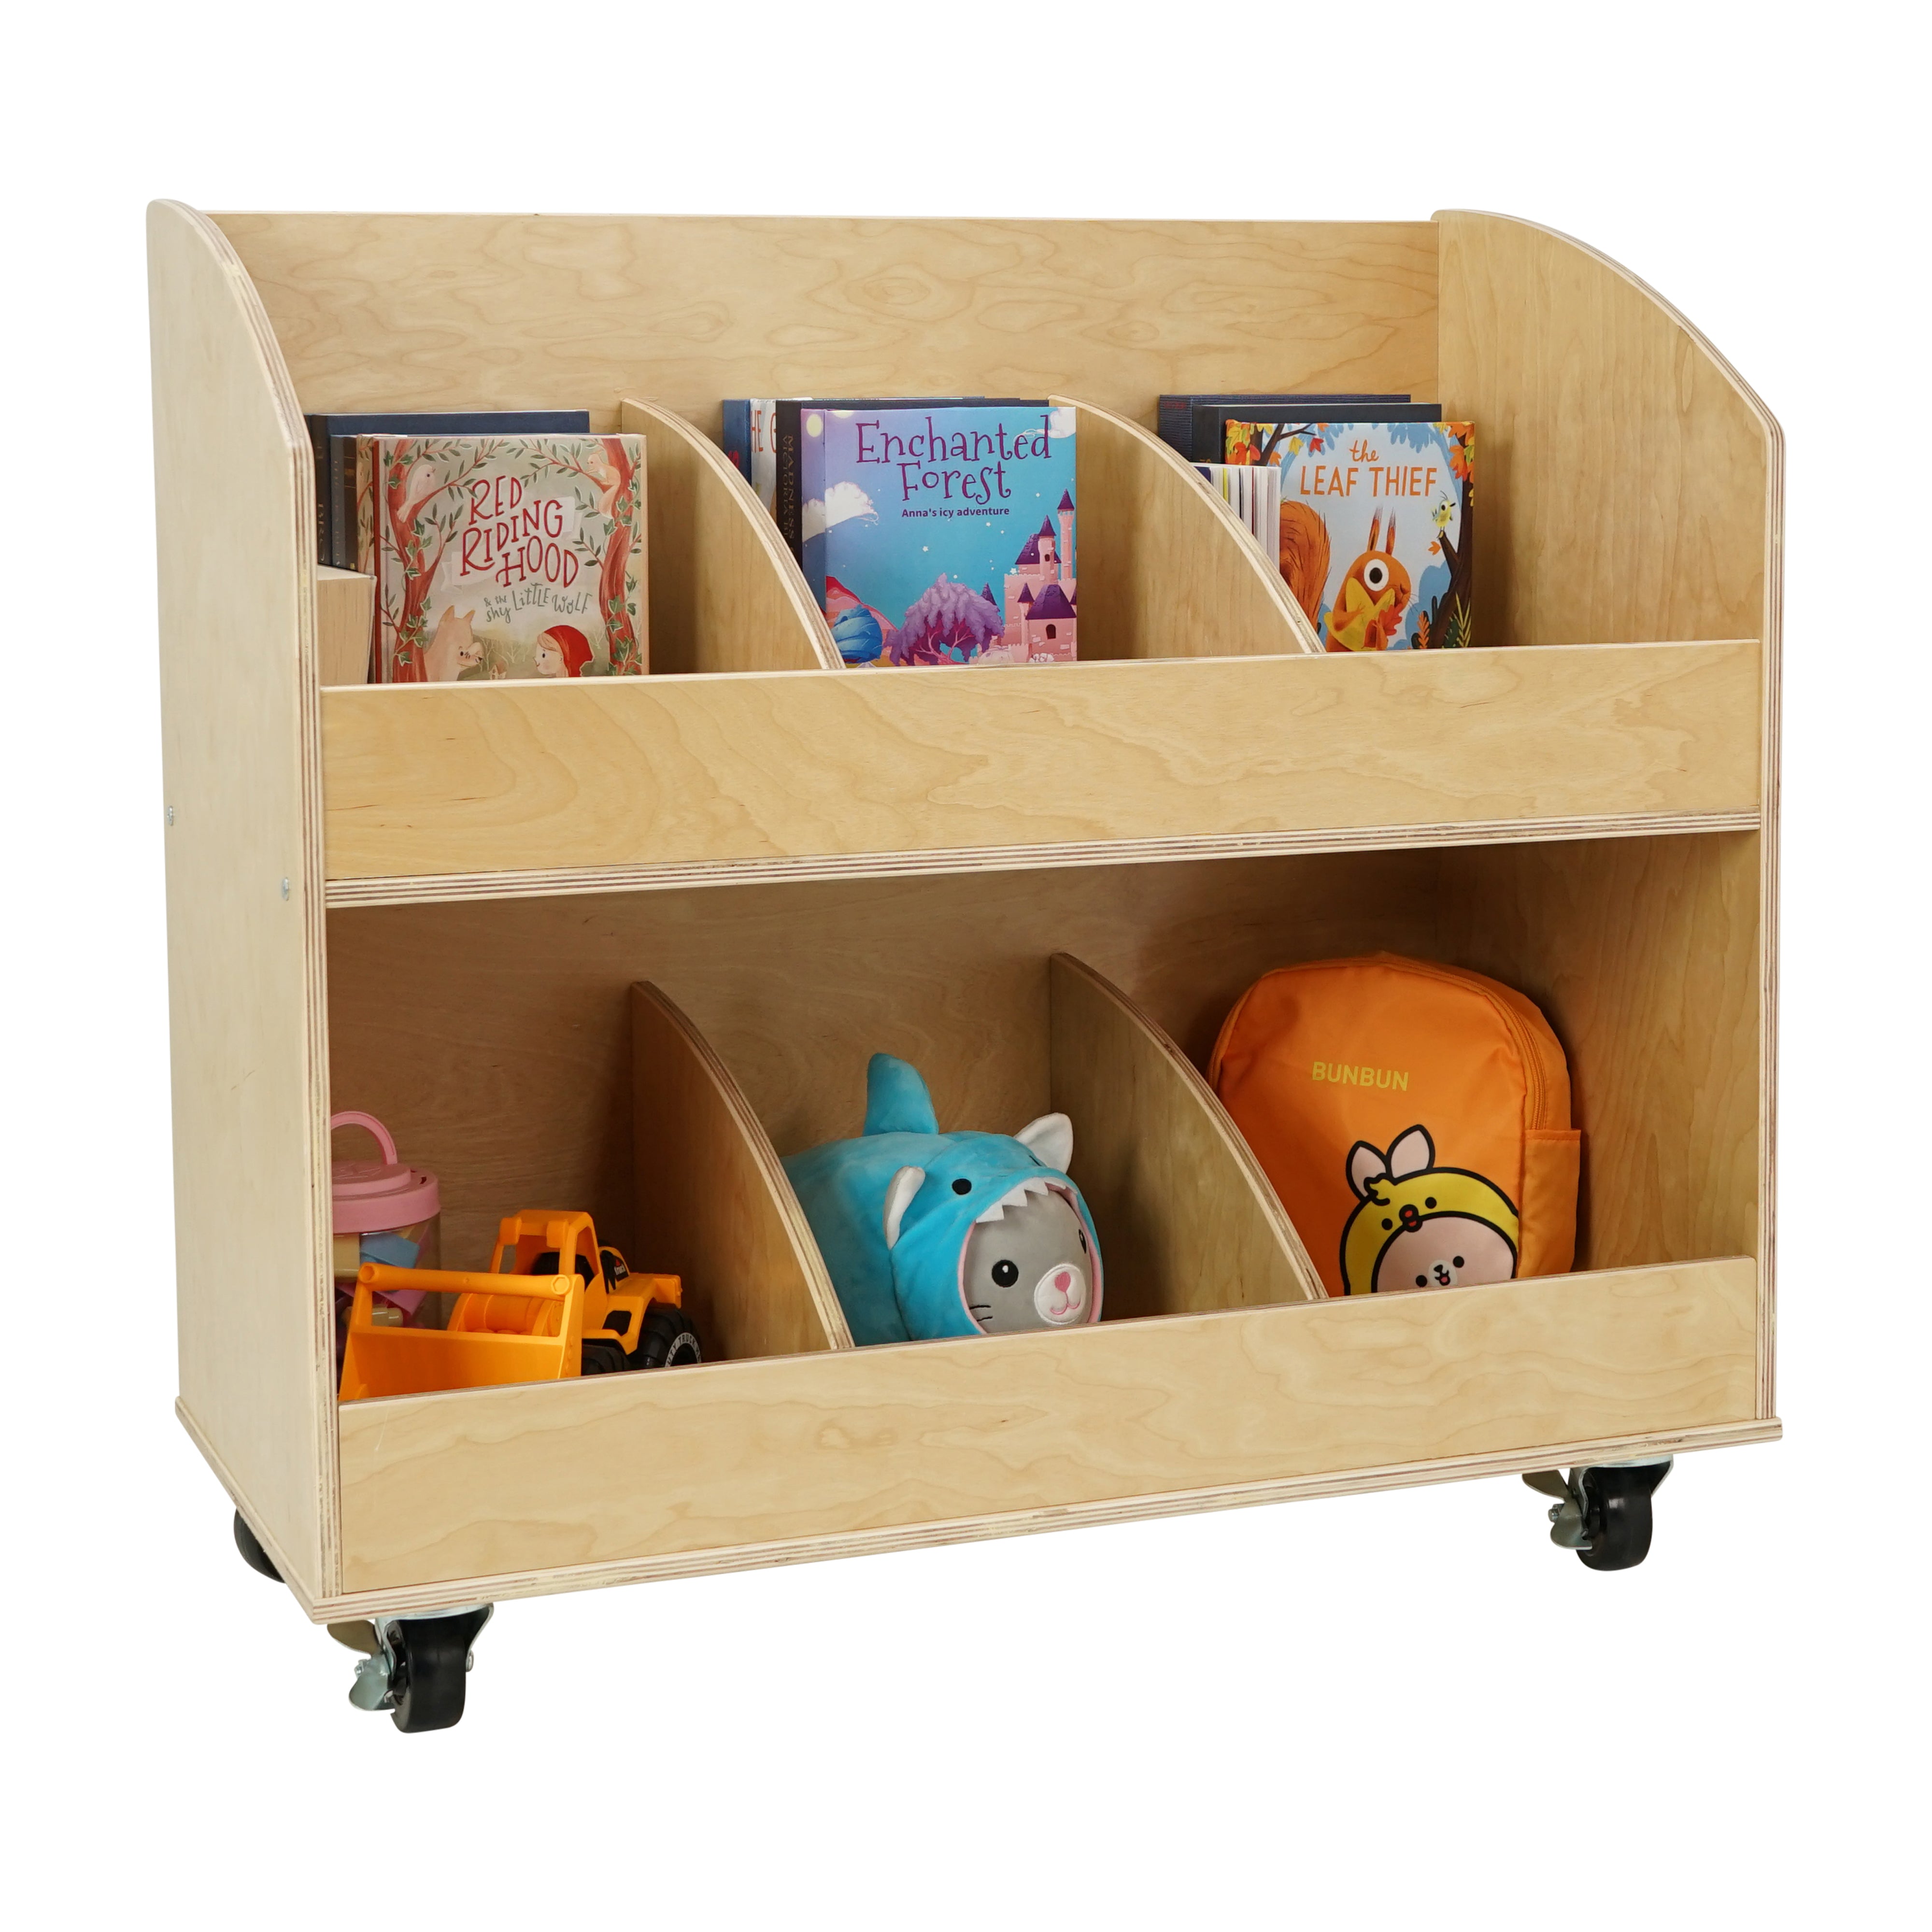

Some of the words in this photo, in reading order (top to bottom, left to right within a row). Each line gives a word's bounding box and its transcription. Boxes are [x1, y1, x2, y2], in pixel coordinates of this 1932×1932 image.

[856, 415, 1051, 463] Enchanted
[1350, 440, 1379, 462] the
[896, 461, 1011, 505] Forest
[1300, 466, 1359, 497] LEAF
[1369, 466, 1437, 497] THIEF
[469, 475, 522, 526] RED
[902, 508, 937, 518] Anna's
[939, 507, 954, 519] icy
[957, 507, 1009, 516] adventure
[460, 500, 563, 576] RIDING
[496, 536, 579, 588] HOOD
[483, 597, 491, 607] &
[495, 595, 507, 604] the
[486, 607, 511, 624] shy
[1312, 1062, 1409, 1091] BUNBUN
